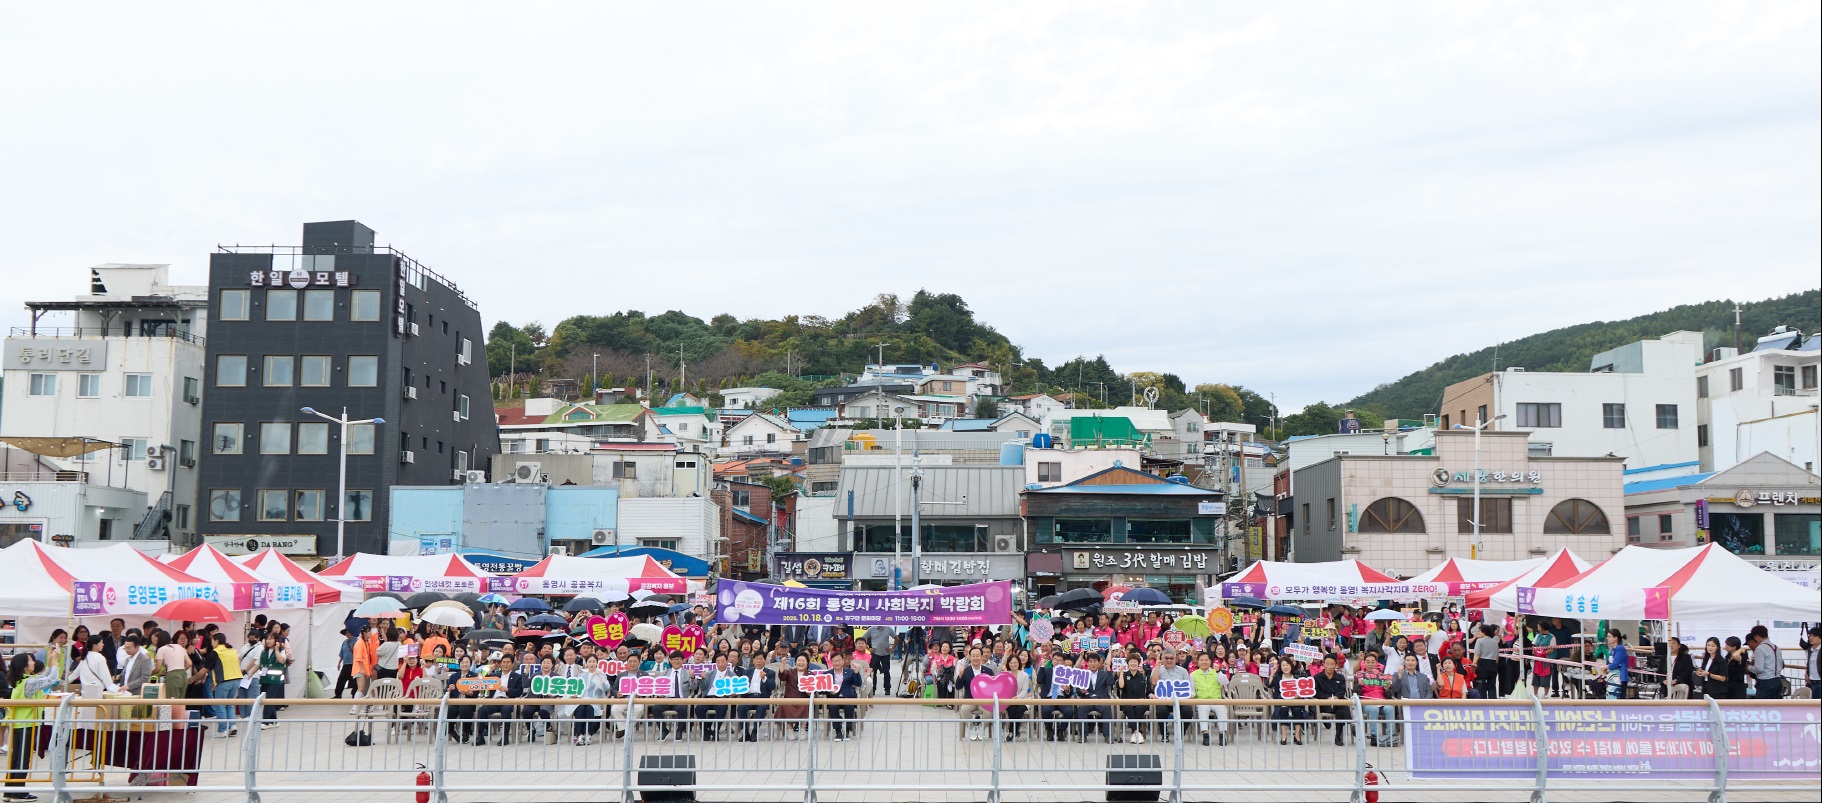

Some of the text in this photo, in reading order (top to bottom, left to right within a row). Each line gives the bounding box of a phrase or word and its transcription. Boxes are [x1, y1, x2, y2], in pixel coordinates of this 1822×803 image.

[250, 271, 350, 287] 한일 모텔
[398, 257, 406, 334] 한일모텔
[18, 346, 92, 364] 통리단길
[781, 561, 802, 575] 길섶
[822, 563, 845, 572] 카페
[1092, 552, 1208, 569] 원조 3代 할매 김밥
[542, 580, 603, 589] 통영시 공공복지
[1285, 585, 1309, 595] 모두가
[1412, 584, 1438, 593] ZERO!
[128, 585, 168, 605] 운영본부
[277, 586, 303, 602] 의료지원
[773, 596, 821, 611] 제16회
[825, 597, 870, 612] 통영시
[875, 597, 934, 612] 사회복지
[940, 595, 985, 612] 박람회
[799, 613, 811, 622] 10.
[811, 613, 823, 622] 18.
[592, 622, 624, 641] 통영
[666, 633, 696, 653] 복지
[620, 676, 671, 695] 마음을
[799, 674, 839, 692] 복지,
[1054, 666, 1090, 687] 함께
[532, 676, 585, 696] 이웃과
[1156, 680, 1190, 698] 사는
[1280, 678, 1316, 698] 통영
